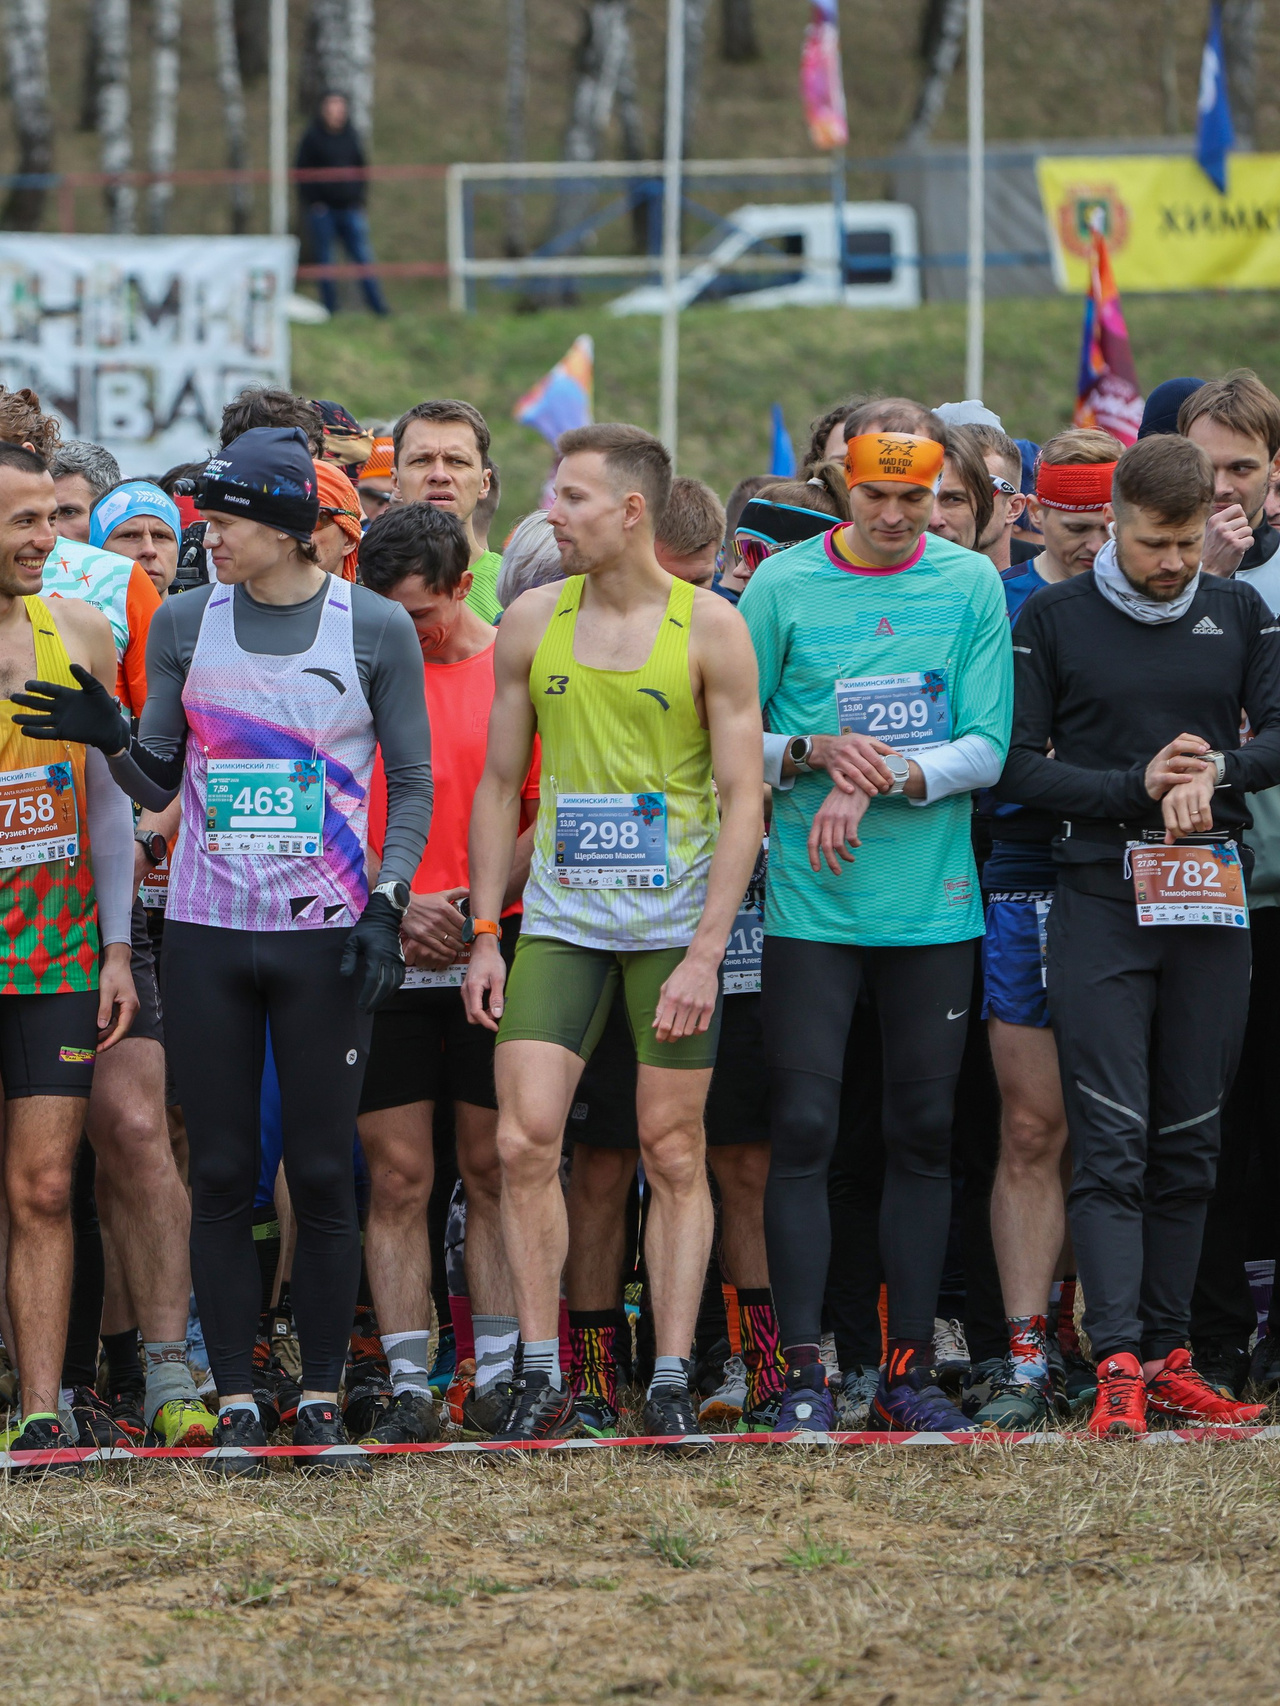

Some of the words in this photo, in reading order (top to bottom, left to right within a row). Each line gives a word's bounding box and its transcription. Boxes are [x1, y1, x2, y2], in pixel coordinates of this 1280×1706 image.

[879, 458, 896, 466] MAD
[898, 458, 913, 467] FOX
[883, 466, 907, 475] ULTRA
[1041, 497, 1108, 511] COMPRESSP
[1191, 627, 1224, 635] adidas
[843, 677, 895, 689] ХИМКИНСКИЙ
[843, 703, 863, 712] 13,00
[867, 699, 929, 732] 299
[871, 732, 910, 742] ворушко
[911, 728, 933, 739] Юрий
[215, 762, 265, 770] ХИМКИНСКИЙ
[24, 771, 37, 779] ЛЕС
[213, 785, 228, 793] 7,50
[232, 786, 294, 815] 463
[562, 796, 608, 804] ХИМКИНСКИЙ
[559, 819, 577, 827] 13,00
[0, 829, 27, 839] Рузиев
[28, 822, 58, 836] Рузибой
[579, 821, 640, 850] 298
[574, 852, 614, 861] Щербаков
[1137, 859, 1158, 867] 27,00
[1160, 860, 1222, 887] 782
[1160, 889, 1201, 898] Тимофеев
[724, 957, 741, 966] бнов
